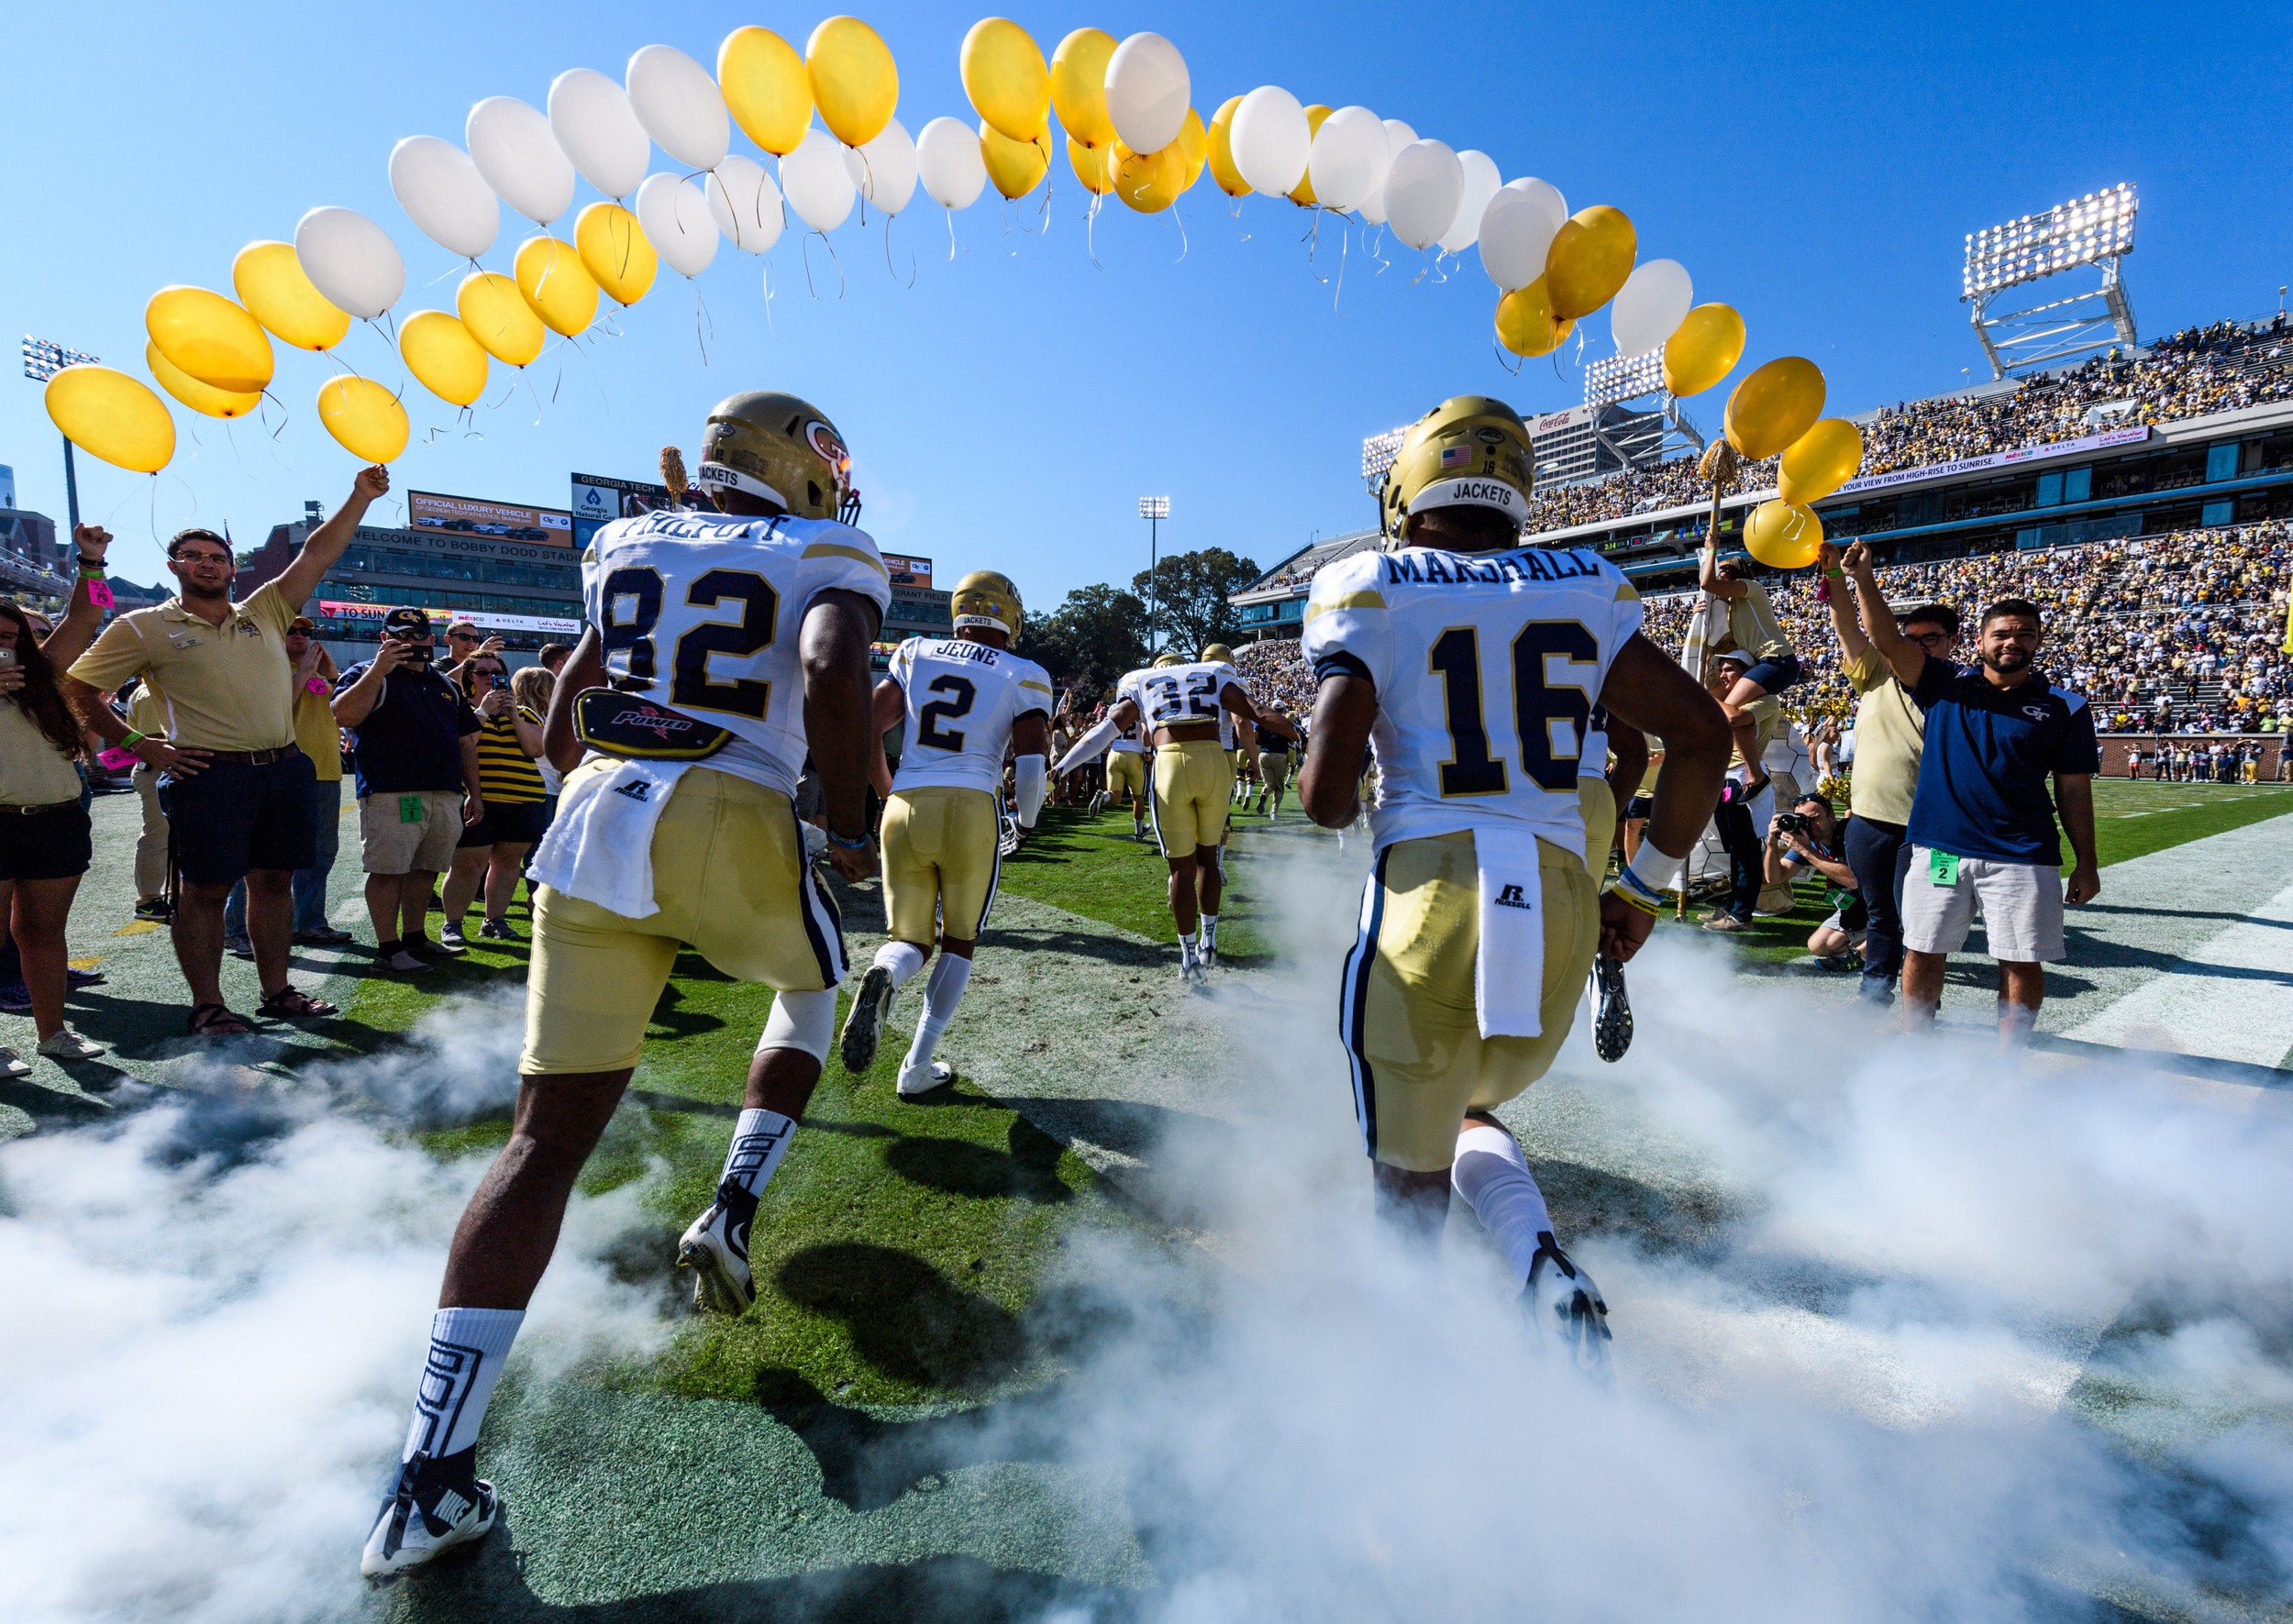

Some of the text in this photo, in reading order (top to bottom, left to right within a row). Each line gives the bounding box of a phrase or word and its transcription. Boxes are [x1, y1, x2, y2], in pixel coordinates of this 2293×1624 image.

[1539, 412, 1570, 431] Coca-Cola
[2117, 430, 2143, 439] Vacation
[2052, 442, 2076, 450] DELTA
[1482, 461, 1496, 474] 16
[1843, 480, 1862, 491] YOUR
[1864, 476, 1882, 487] VIEW
[1884, 473, 1905, 484] FROM
[1906, 464, 1944, 480] HIGH-RISE
[1946, 460, 1957, 471] TO
[1958, 457, 1996, 470] SUNRISE.
[581, 475, 655, 493] GEORGIA TECH
[698, 466, 738, 486] JACKETS
[1453, 482, 1512, 506] JACKETS
[415, 497, 532, 519] OFFICIAL LUXURY VEHICLE
[425, 505, 450, 514] GEORGIA
[575, 511, 602, 519] Natural
[581, 504, 607, 514] Georgia
[353, 529, 422, 547] WELCOME
[427, 537, 446, 548] TO
[450, 541, 496, 553] BOBBY
[501, 546, 537, 558] DODD
[96, 591, 108, 602] PG
[893, 589, 947, 602] GRANT FIELD
[341, 607, 386, 620] TO SUN
[399, 611, 421, 623] GT
[963, 615, 991, 626] JACKETS
[602, 565, 780, 723] 82
[936, 642, 1000, 667] JEUNE
[1145, 671, 1221, 723] 32
[916, 673, 977, 753] 2
[1428, 618, 1600, 799] 16
[2022, 705, 2050, 722] GT
[611, 711, 692, 731] POWER
[614, 786, 648, 802] RUSSELL
[409, 810, 415, 819] 1
[1938, 867, 1948, 879] 2
[1494, 898, 1531, 910] RUSSELL
[1349, 1488, 1389, 1529] NIKE
